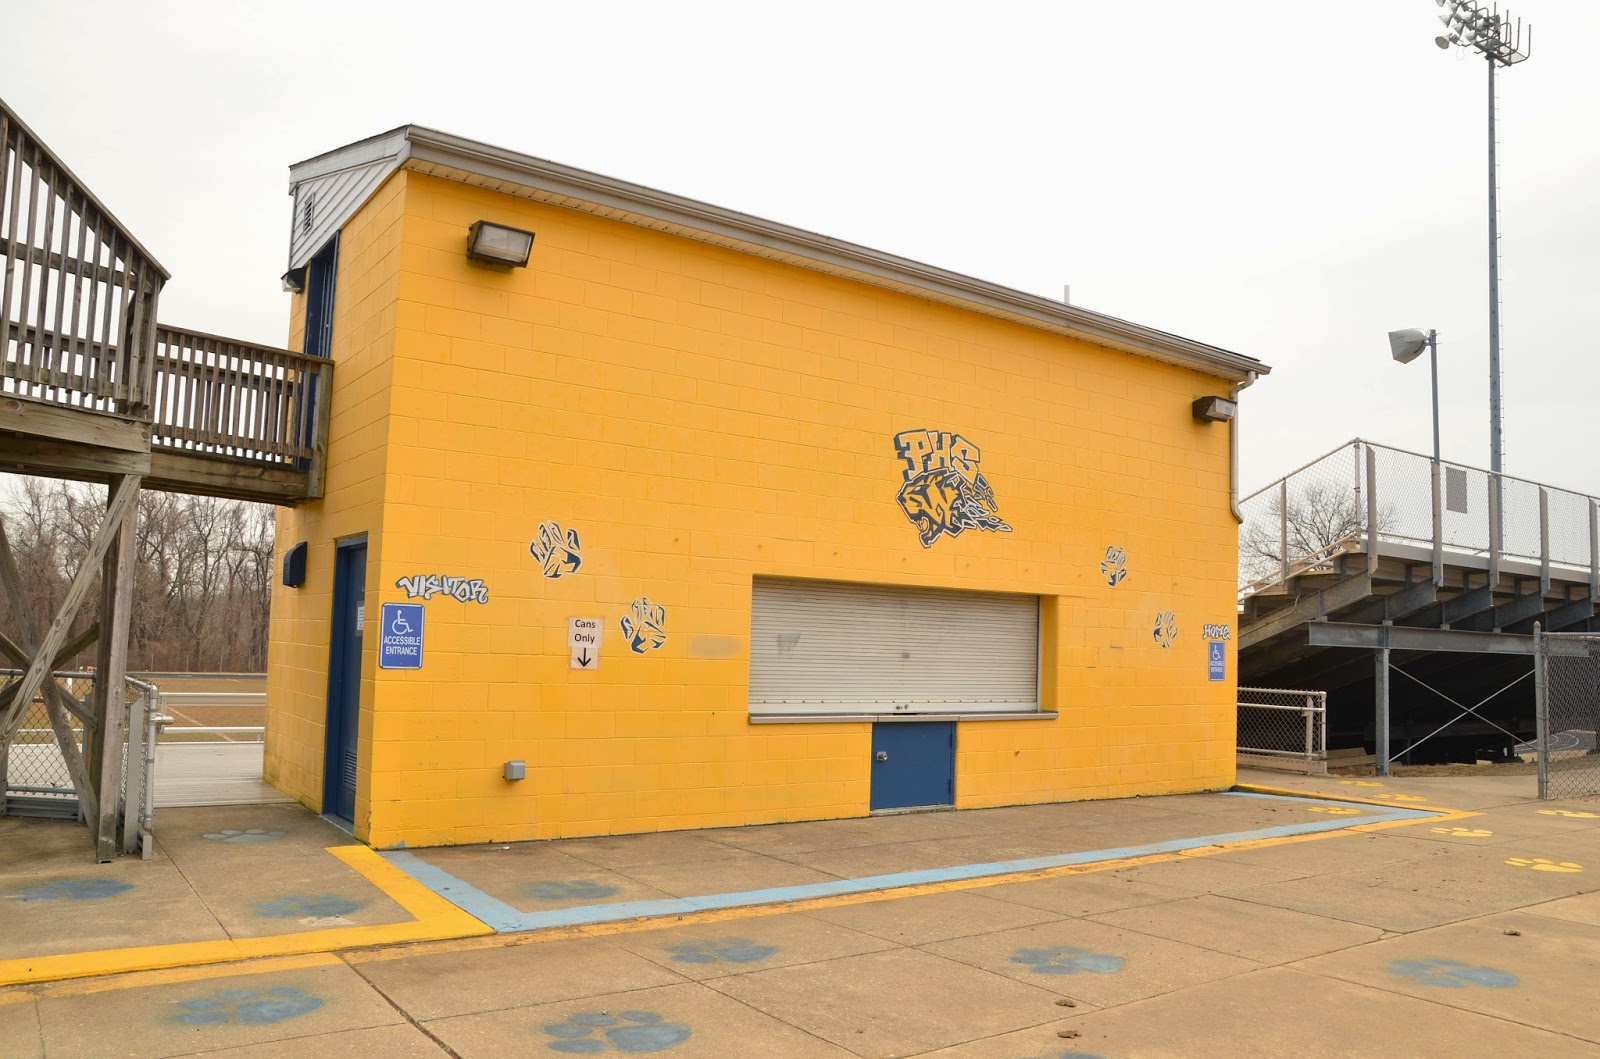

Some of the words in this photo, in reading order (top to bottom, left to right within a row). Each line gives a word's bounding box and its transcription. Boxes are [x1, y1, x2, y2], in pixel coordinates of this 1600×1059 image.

[894, 429, 980, 485] PHS
[395, 574, 489, 604] VISITOR
[574, 619, 596, 629] Cans
[383, 635, 421, 646] ACCESSIBLE
[574, 633, 595, 645] Only
[385, 646, 418, 656] ENTRANCE
